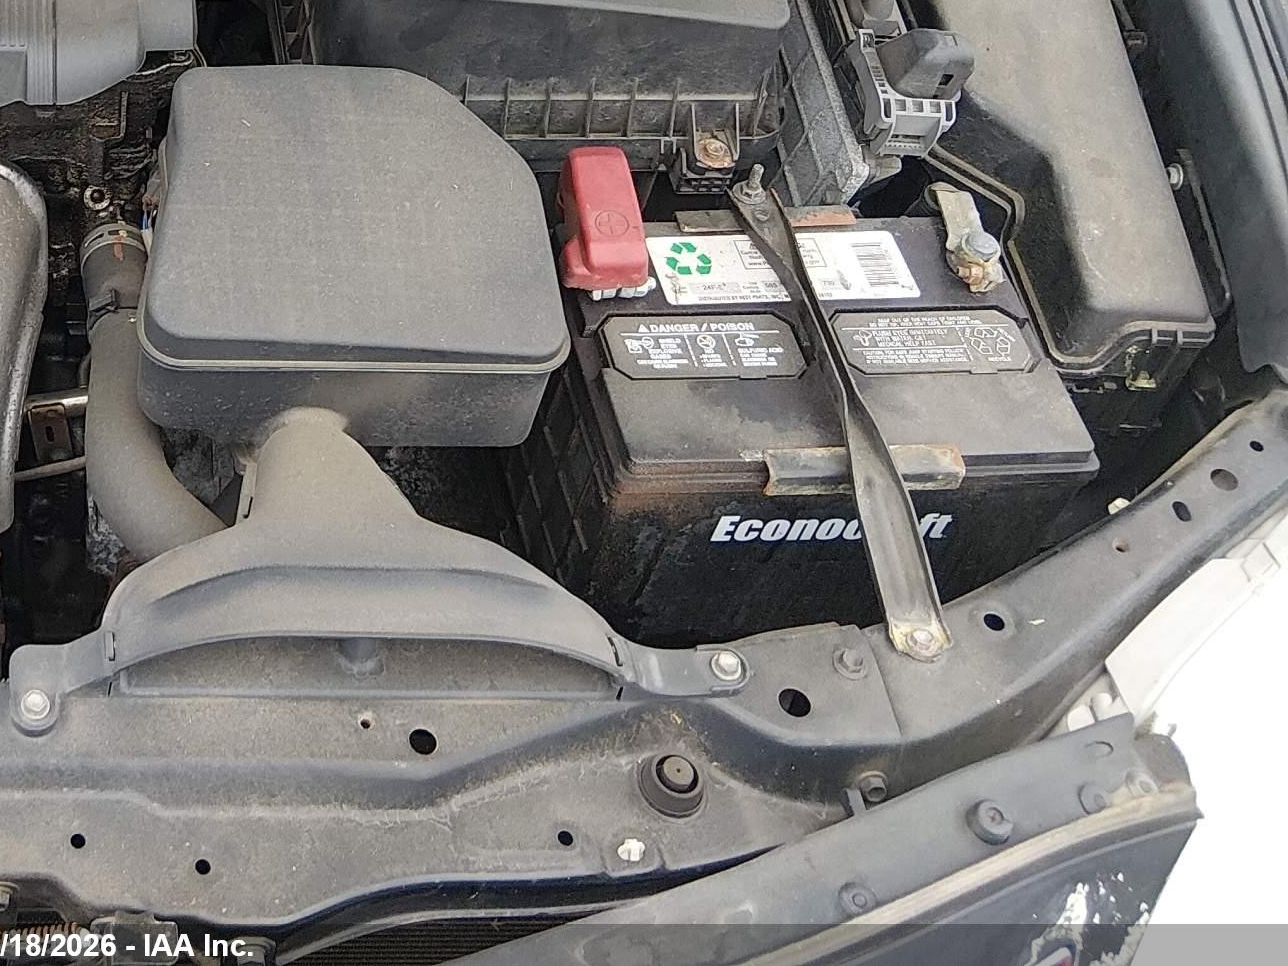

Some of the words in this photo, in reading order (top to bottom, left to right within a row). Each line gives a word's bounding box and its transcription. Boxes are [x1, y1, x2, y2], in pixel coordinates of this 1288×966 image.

[649, 323, 699, 332] DANGER
[700, 322, 708, 332] /
[709, 322, 755, 331] POISON
[909, 328, 948, 336] IMMEDIATELY
